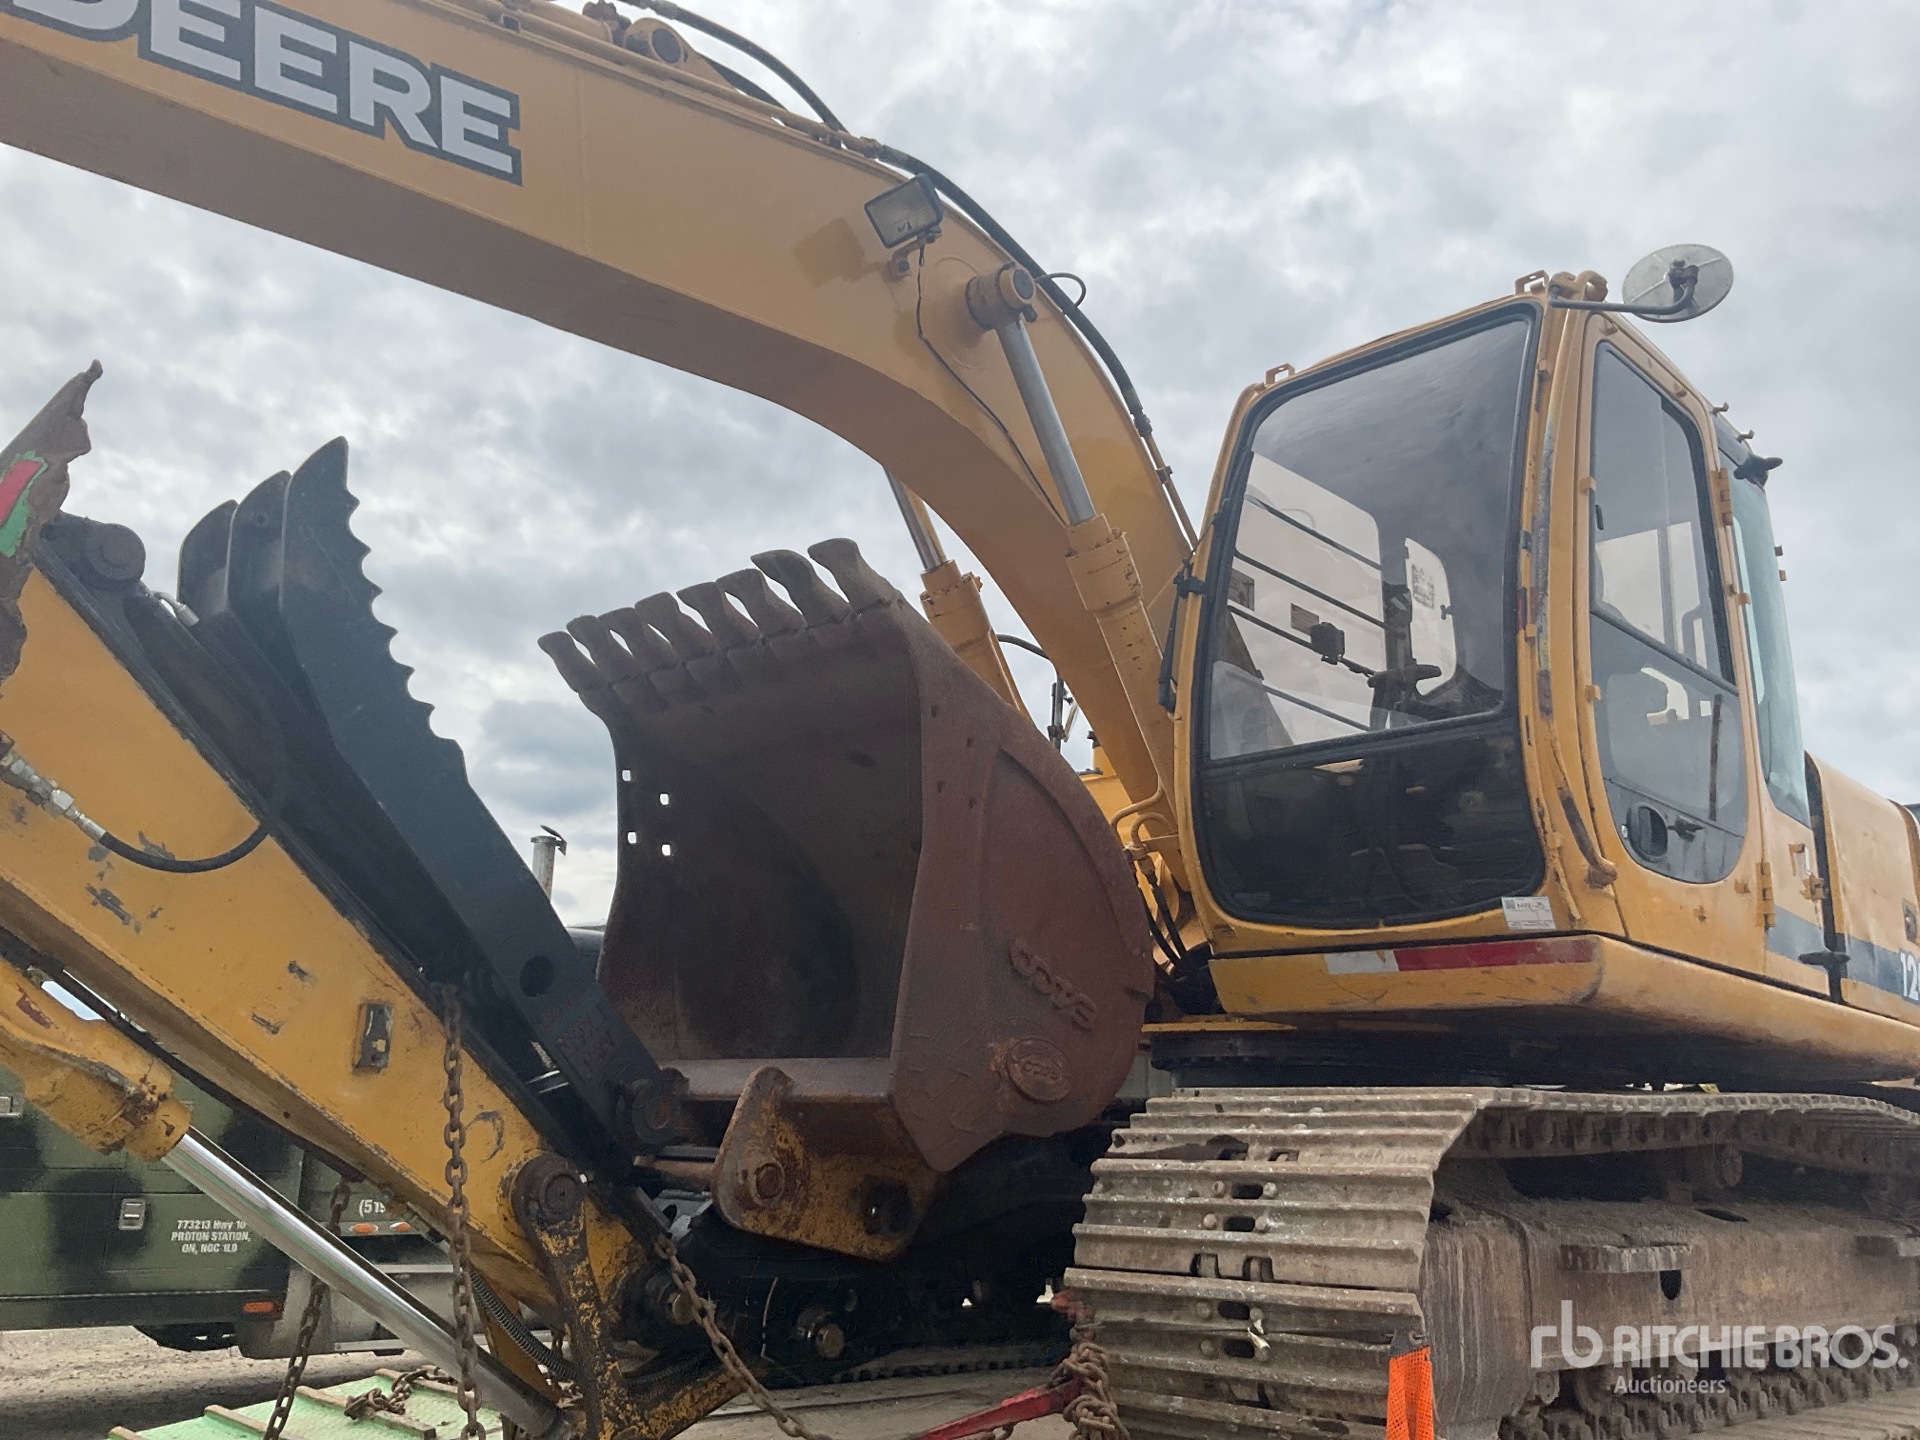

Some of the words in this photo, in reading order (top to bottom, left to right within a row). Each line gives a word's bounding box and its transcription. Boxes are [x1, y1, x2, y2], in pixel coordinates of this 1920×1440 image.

[10, 0, 516, 176] EERE
[1899, 951, 1920, 1002] 12
[170, 1231, 210, 1242] PROTON
[210, 1231, 251, 1243] STATION,
[177, 1219, 211, 1230] 773213
[212, 1219, 234, 1231] Hwy
[235, 1219, 246, 1230] 10
